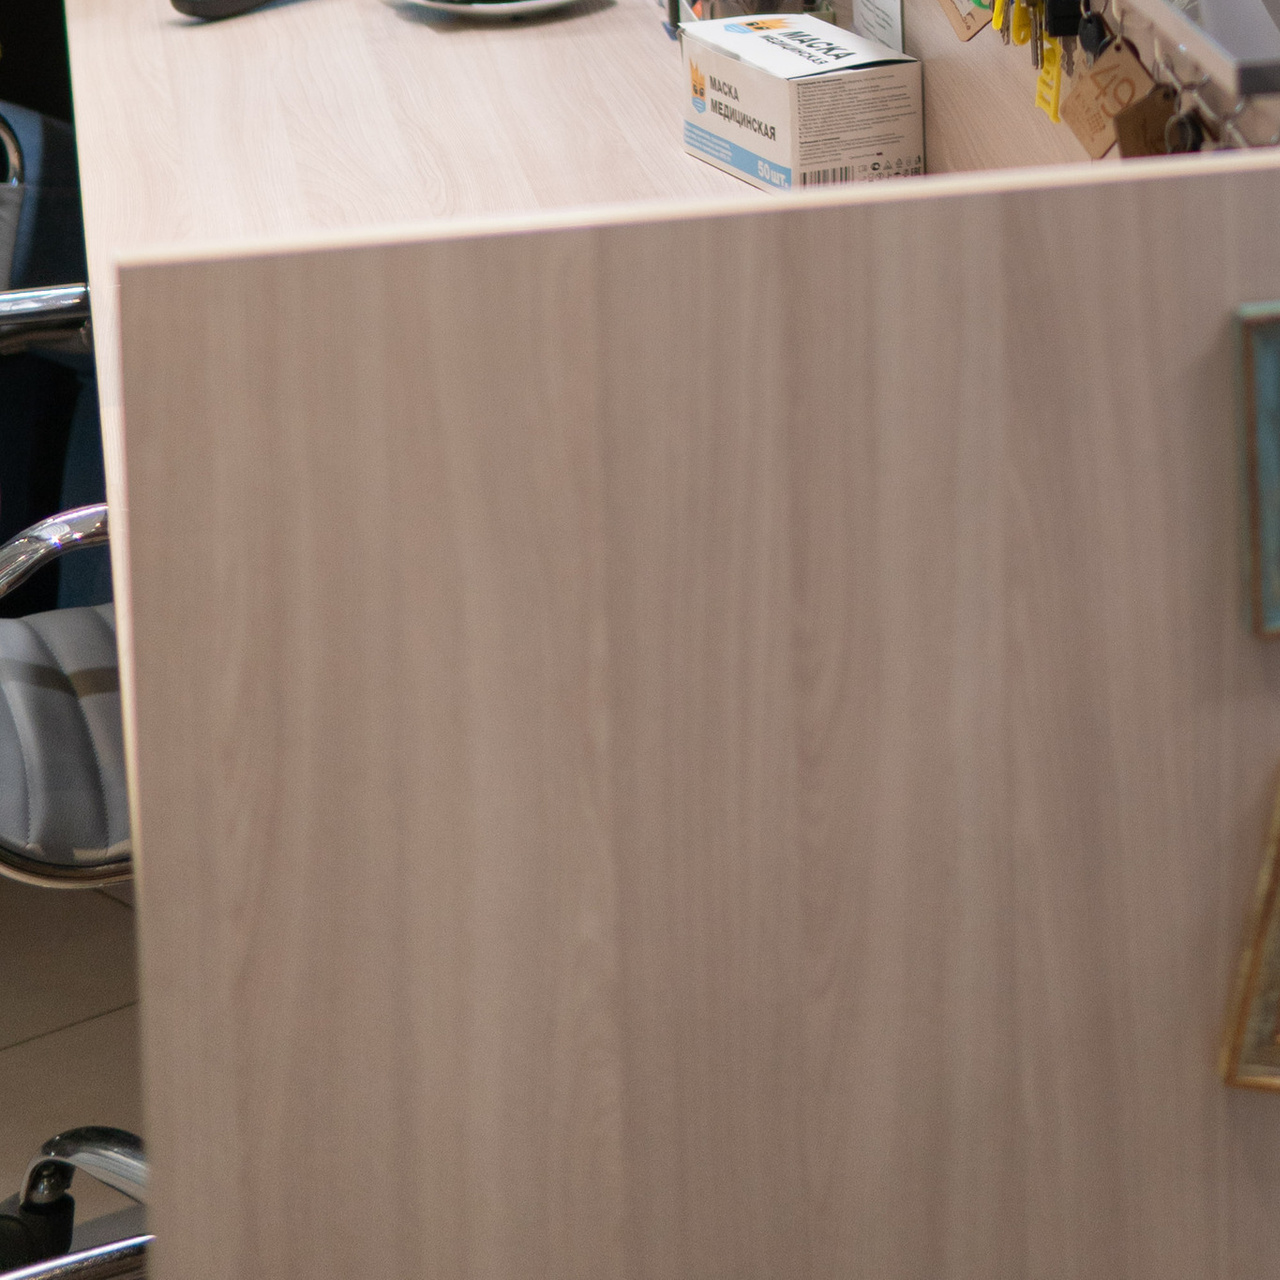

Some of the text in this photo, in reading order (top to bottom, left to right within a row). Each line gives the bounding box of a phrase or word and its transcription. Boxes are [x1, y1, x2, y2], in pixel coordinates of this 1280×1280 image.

[778, 30, 856, 61] МАСКА
[709, 74, 740, 103] МАСКА
[710, 97, 776, 142] МЕДИЦИНСКАЯ
[757, 159, 771, 181] 50
